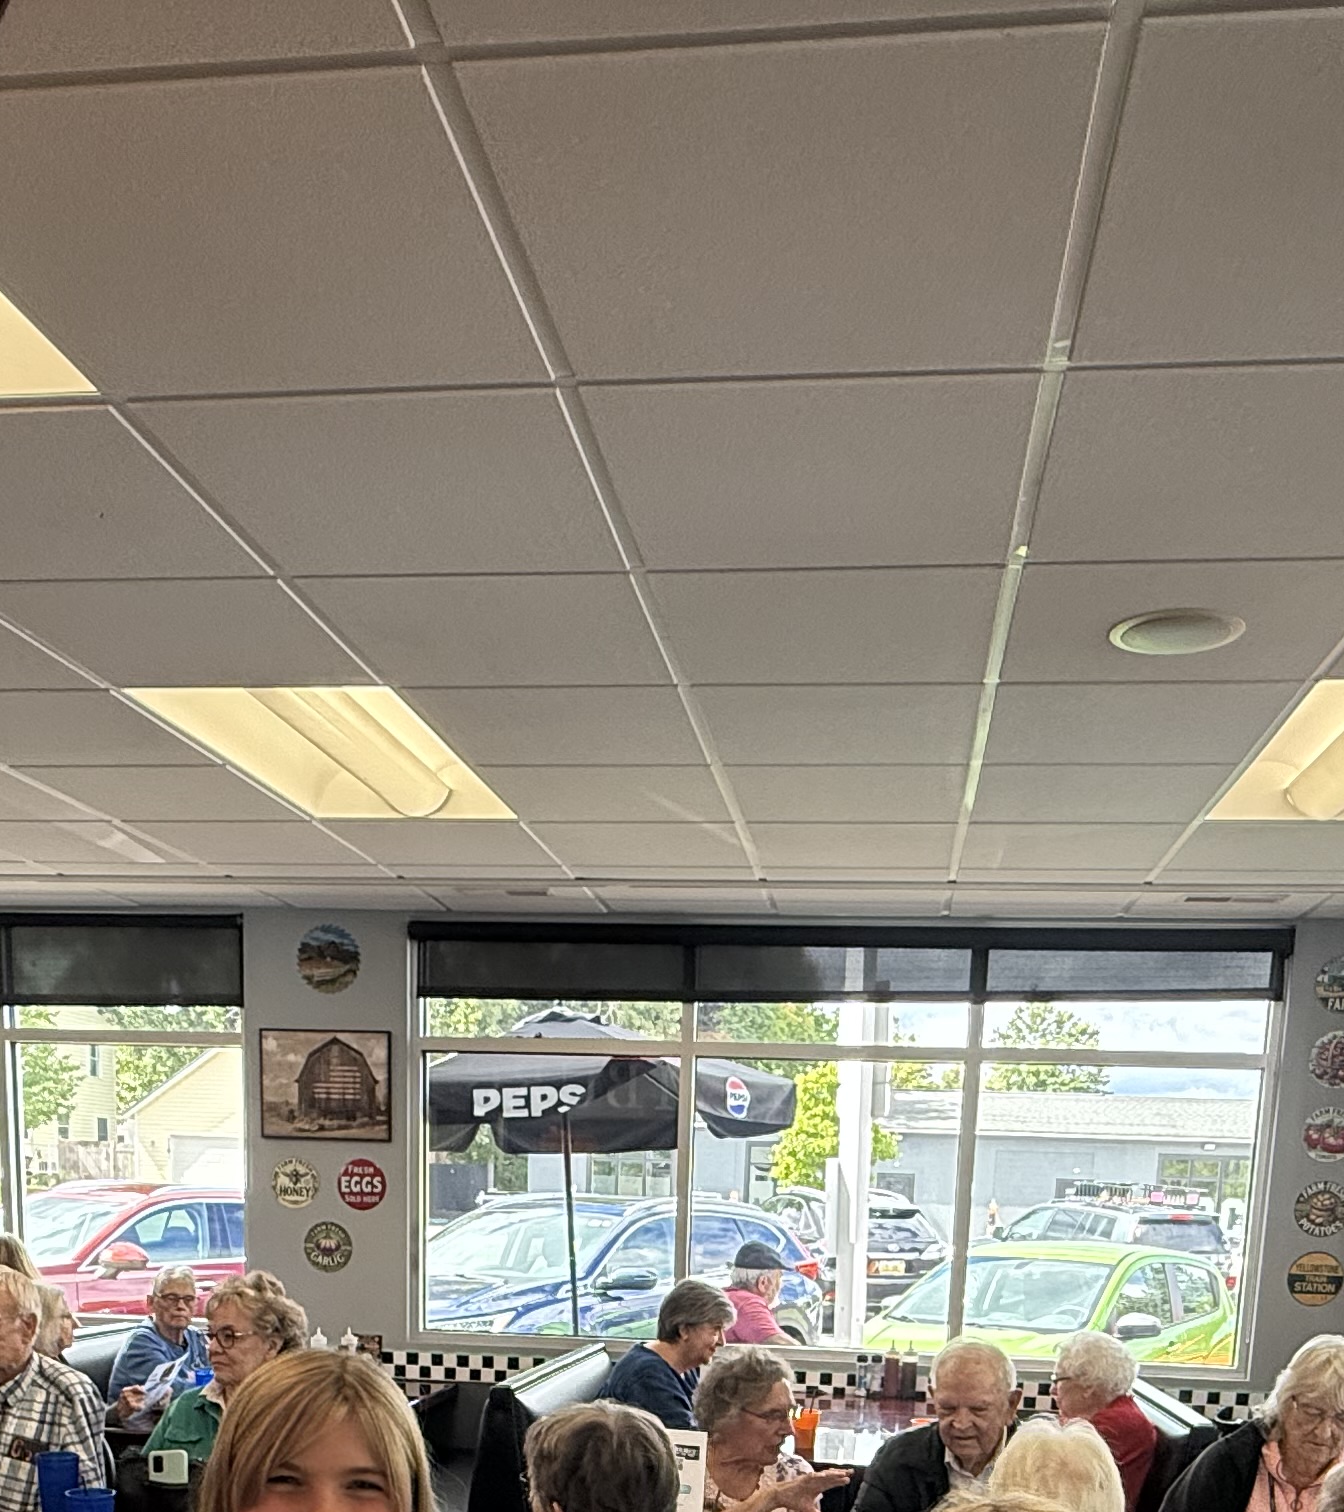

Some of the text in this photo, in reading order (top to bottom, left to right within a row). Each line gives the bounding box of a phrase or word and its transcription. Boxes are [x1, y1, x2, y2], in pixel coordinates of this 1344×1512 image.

[472, 1084, 586, 1117] PEPS
[1311, 1108, 1331, 1122] FARM
[348, 1165, 374, 1174] FRESH
[340, 1176, 383, 1193] EGGS
[279, 1185, 312, 1198] HONEY
[345, 1194, 380, 1203] SOLD HERE
[1298, 1217, 1344, 1236] POTATOES
[310, 1252, 345, 1266] GARLIC
[1295, 1263, 1339, 1274] YELLOWSTONE
[1294, 1282, 1336, 1293] STATION
